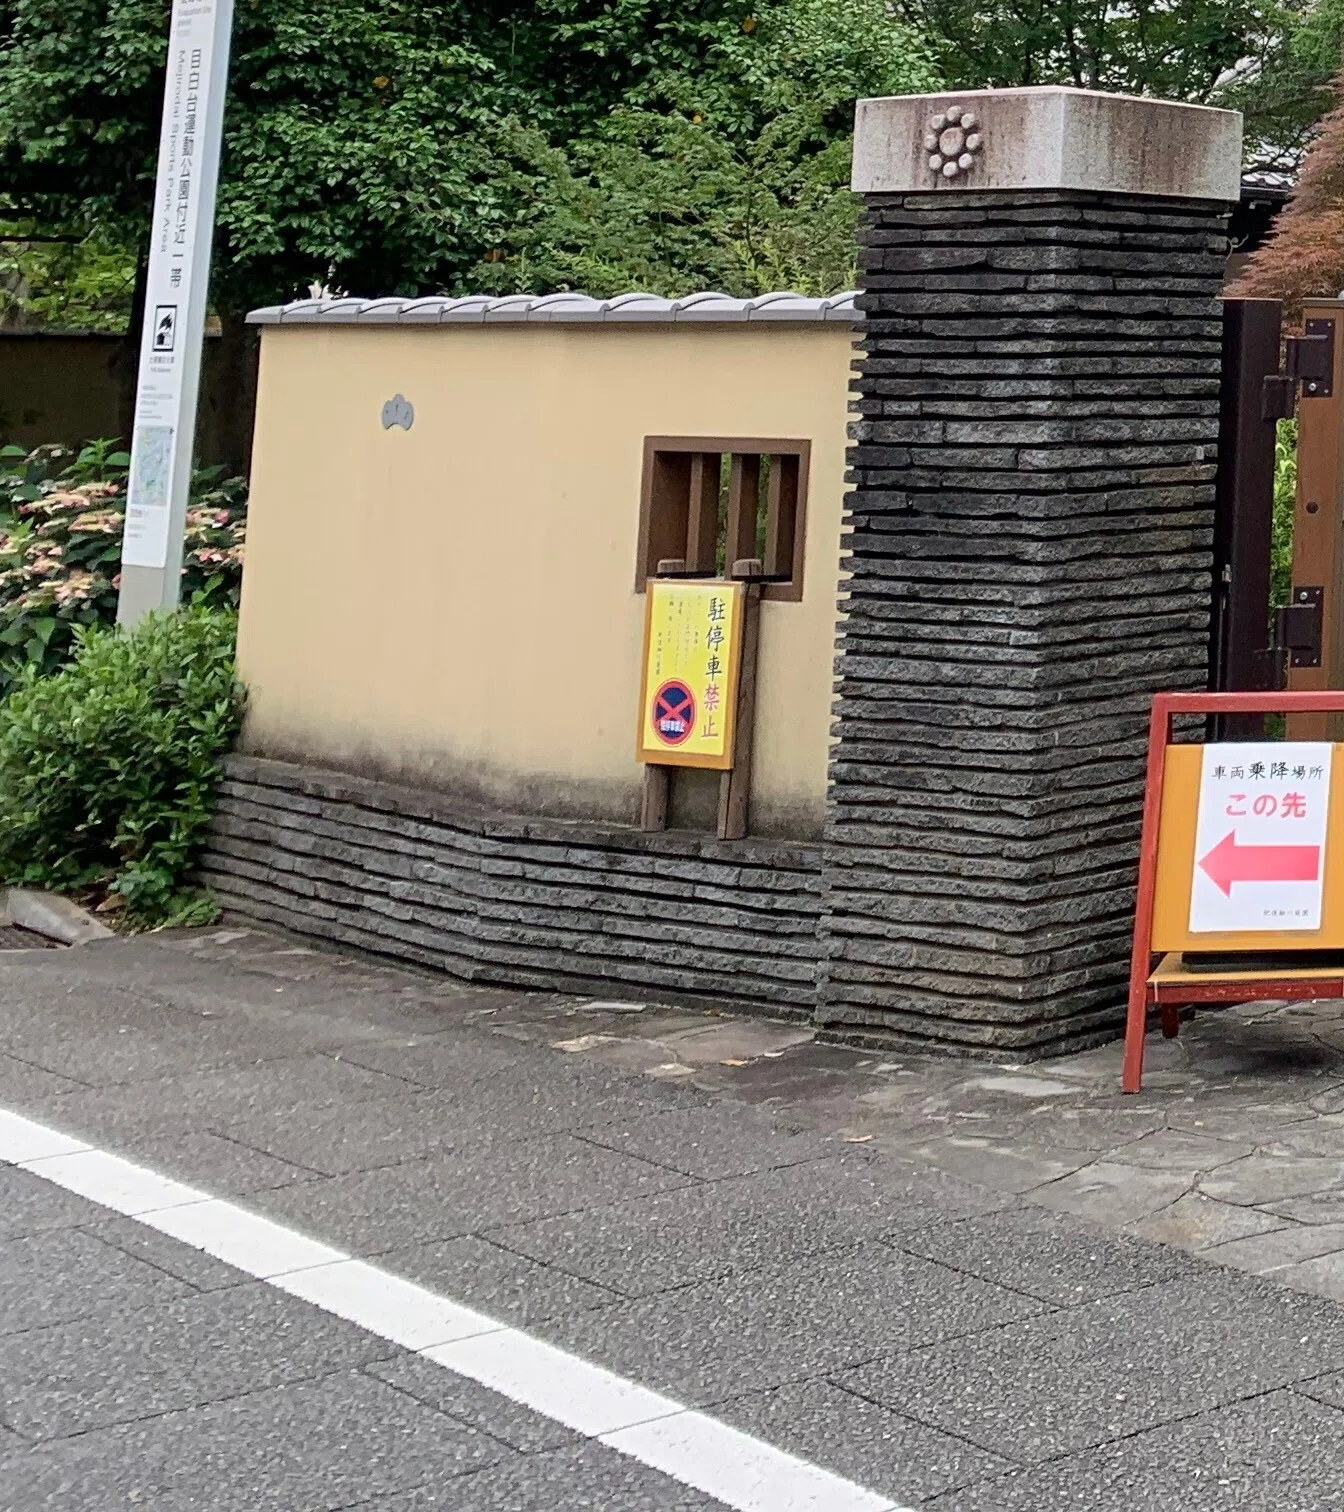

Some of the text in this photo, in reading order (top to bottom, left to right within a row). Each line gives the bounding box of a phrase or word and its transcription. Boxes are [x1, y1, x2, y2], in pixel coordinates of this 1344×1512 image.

[701, 597, 726, 738] 駐停車禁止
[1211, 761, 1325, 781] 車両乗降場所
[1225, 792, 1307, 819] この先
